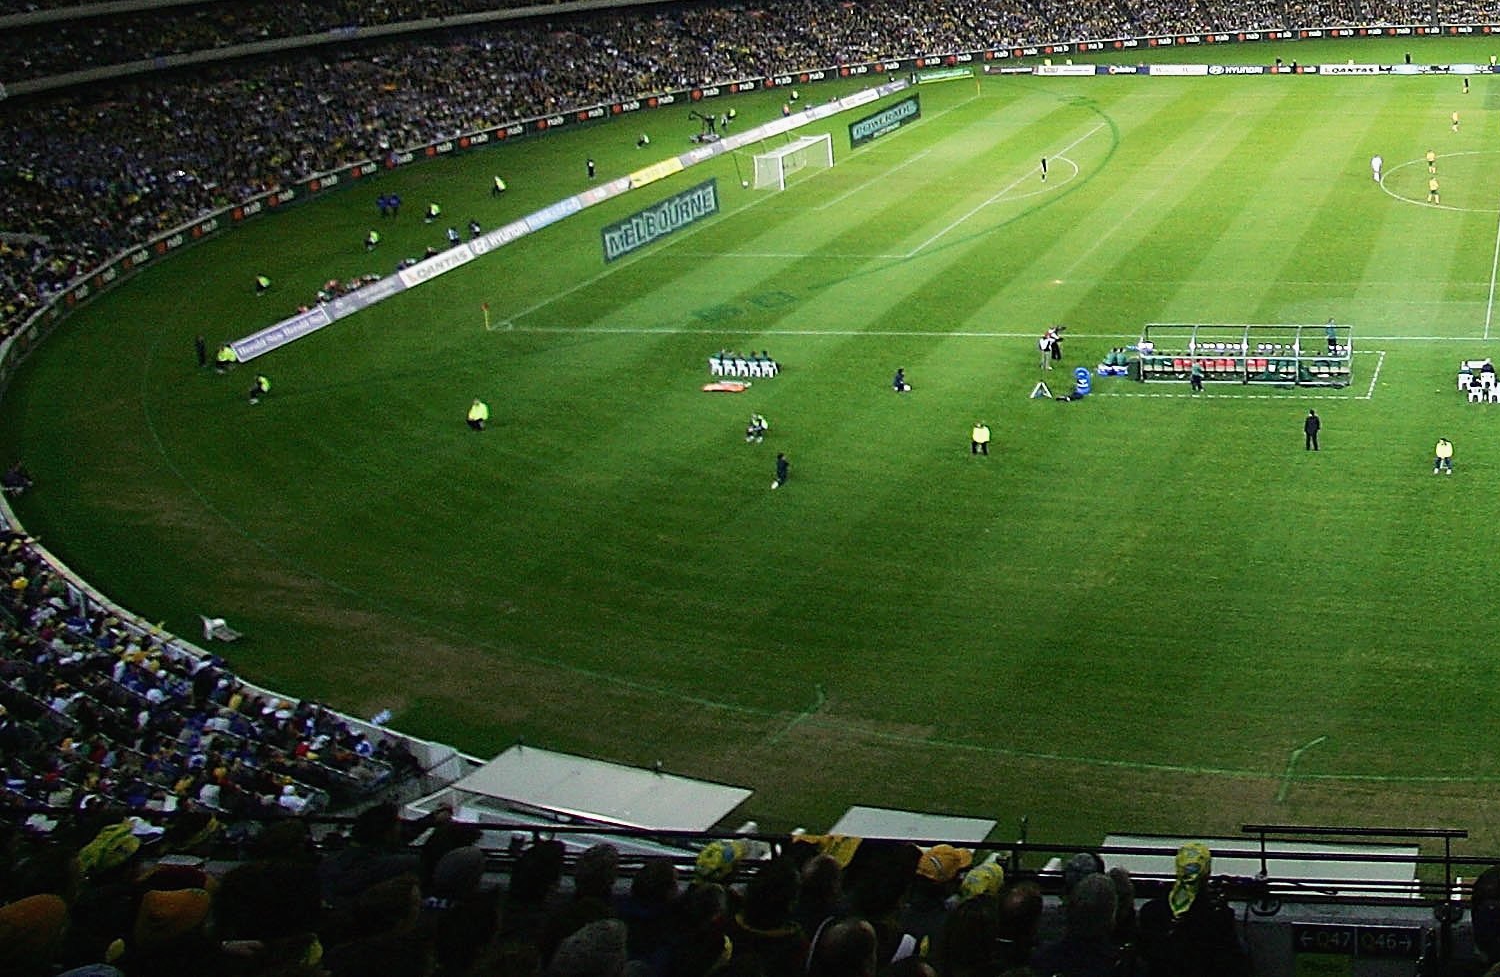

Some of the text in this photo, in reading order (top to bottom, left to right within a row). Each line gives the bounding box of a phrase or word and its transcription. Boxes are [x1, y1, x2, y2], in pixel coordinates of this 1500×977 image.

[1339, 28, 1354, 36] nab
[1395, 27, 1410, 35] nab
[1185, 36, 1199, 44] nab
[1246, 32, 1259, 40] nab
[1123, 39, 1138, 47] nab
[1158, 37, 1172, 45] nab
[1054, 44, 1069, 53] nab
[1088, 42, 1103, 50] nab
[994, 50, 1008, 58] nab
[1023, 47, 1037, 56] nab
[925, 56, 940, 65] nab
[956, 54, 971, 62] nab
[884, 61, 899, 70] nab
[1224, 65, 1264, 74] HYUNDAI
[1332, 66, 1374, 74] QANTAS
[851, 66, 867, 75] nab
[776, 76, 792, 85] nab
[810, 72, 824, 80] nab
[739, 81, 754, 91] nab
[703, 87, 719, 96] nab
[658, 95, 674, 105] nab
[623, 101, 639, 112] nab
[588, 109, 603, 118] nab
[548, 117, 564, 126] nab
[507, 126, 522, 135] nab
[471, 134, 488, 144] nab
[604, 184, 716, 260] MELBOURNE
[416, 250, 468, 278] QANTAS
